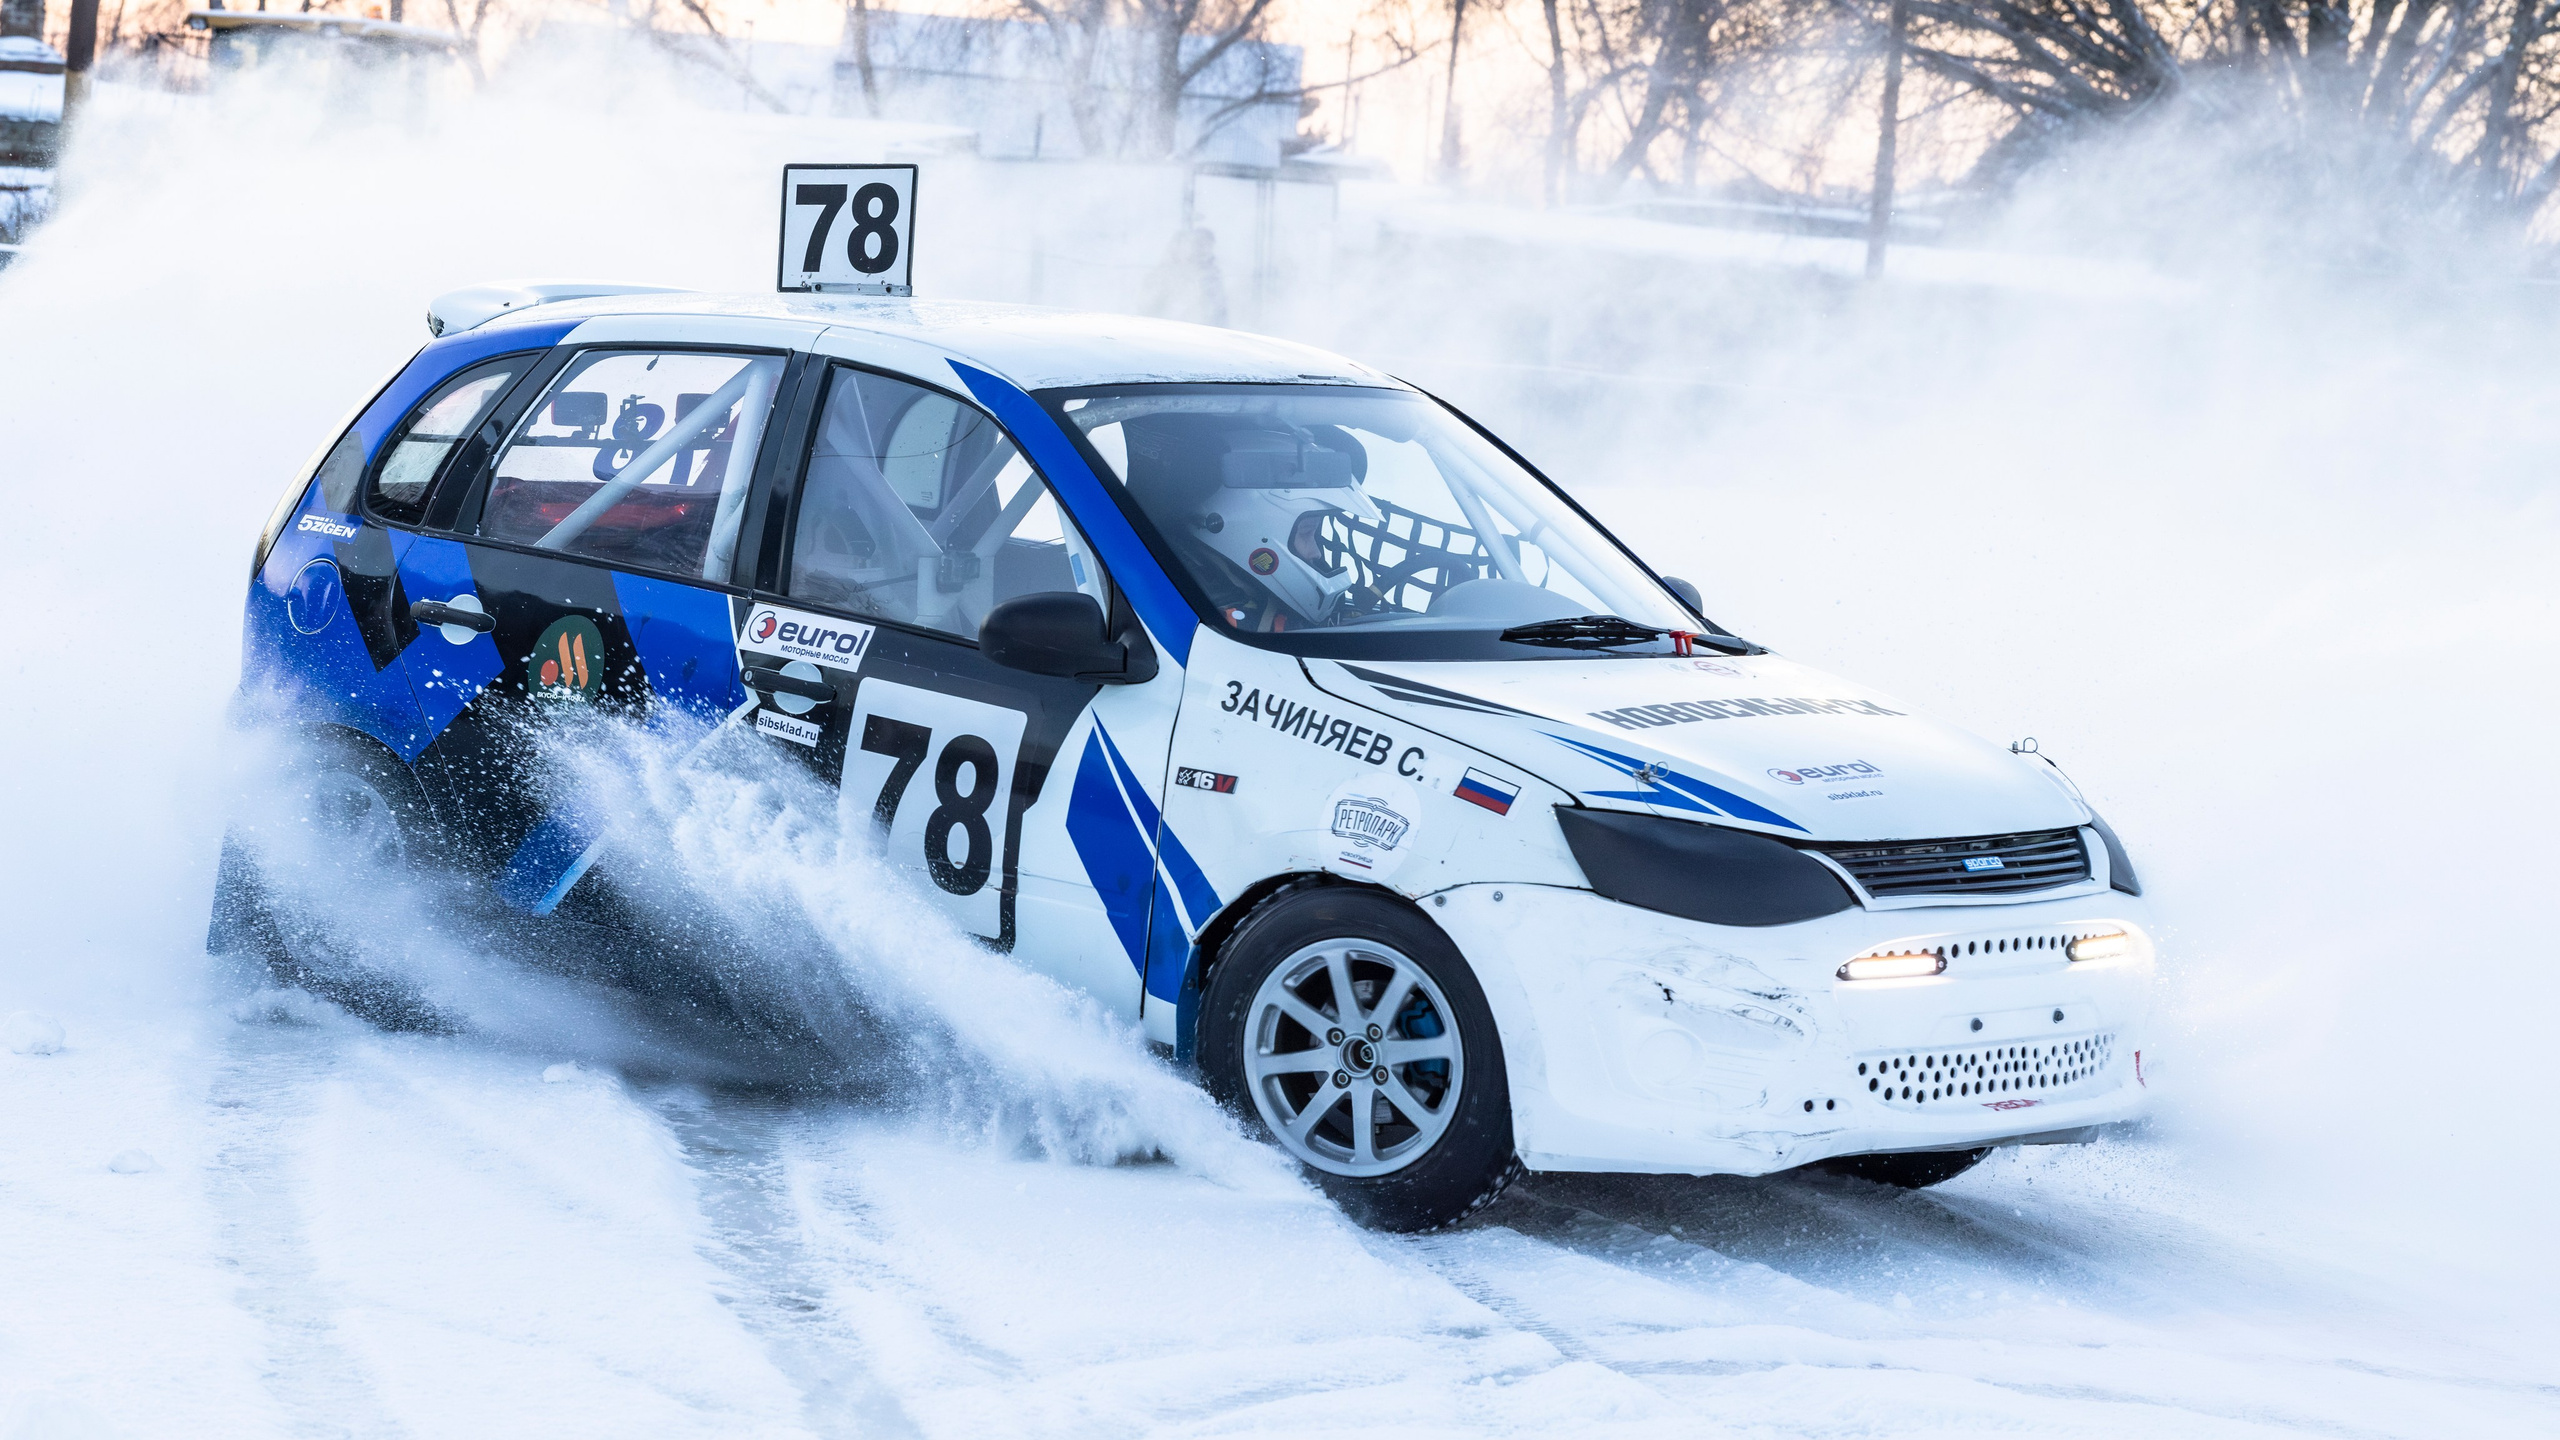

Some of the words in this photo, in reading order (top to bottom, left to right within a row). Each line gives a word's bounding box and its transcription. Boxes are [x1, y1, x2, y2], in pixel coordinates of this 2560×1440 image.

[795, 182, 900, 275] 78
[297, 514, 357, 539] 5ZIGEN
[778, 621, 870, 656] eurol
[780, 644, 822, 659] моторные
[822, 652, 850, 665] масла
[1587, 697, 1909, 731] НОВОСИБИРСК
[757, 716, 817, 742] sibsklad.ru
[1220, 680, 1393, 765] ЗАЧИНЯЕВ
[1397, 746, 1425, 782] С.
[1796, 759, 1882, 778] eurol
[1192, 772, 1234, 793] 16V
[1827, 789, 1884, 801] sibsklad.ru
[861, 714, 999, 896] 78
[1339, 809, 1402, 843] РЕТРОПАРК
[1965, 856, 2003, 869] sparco
